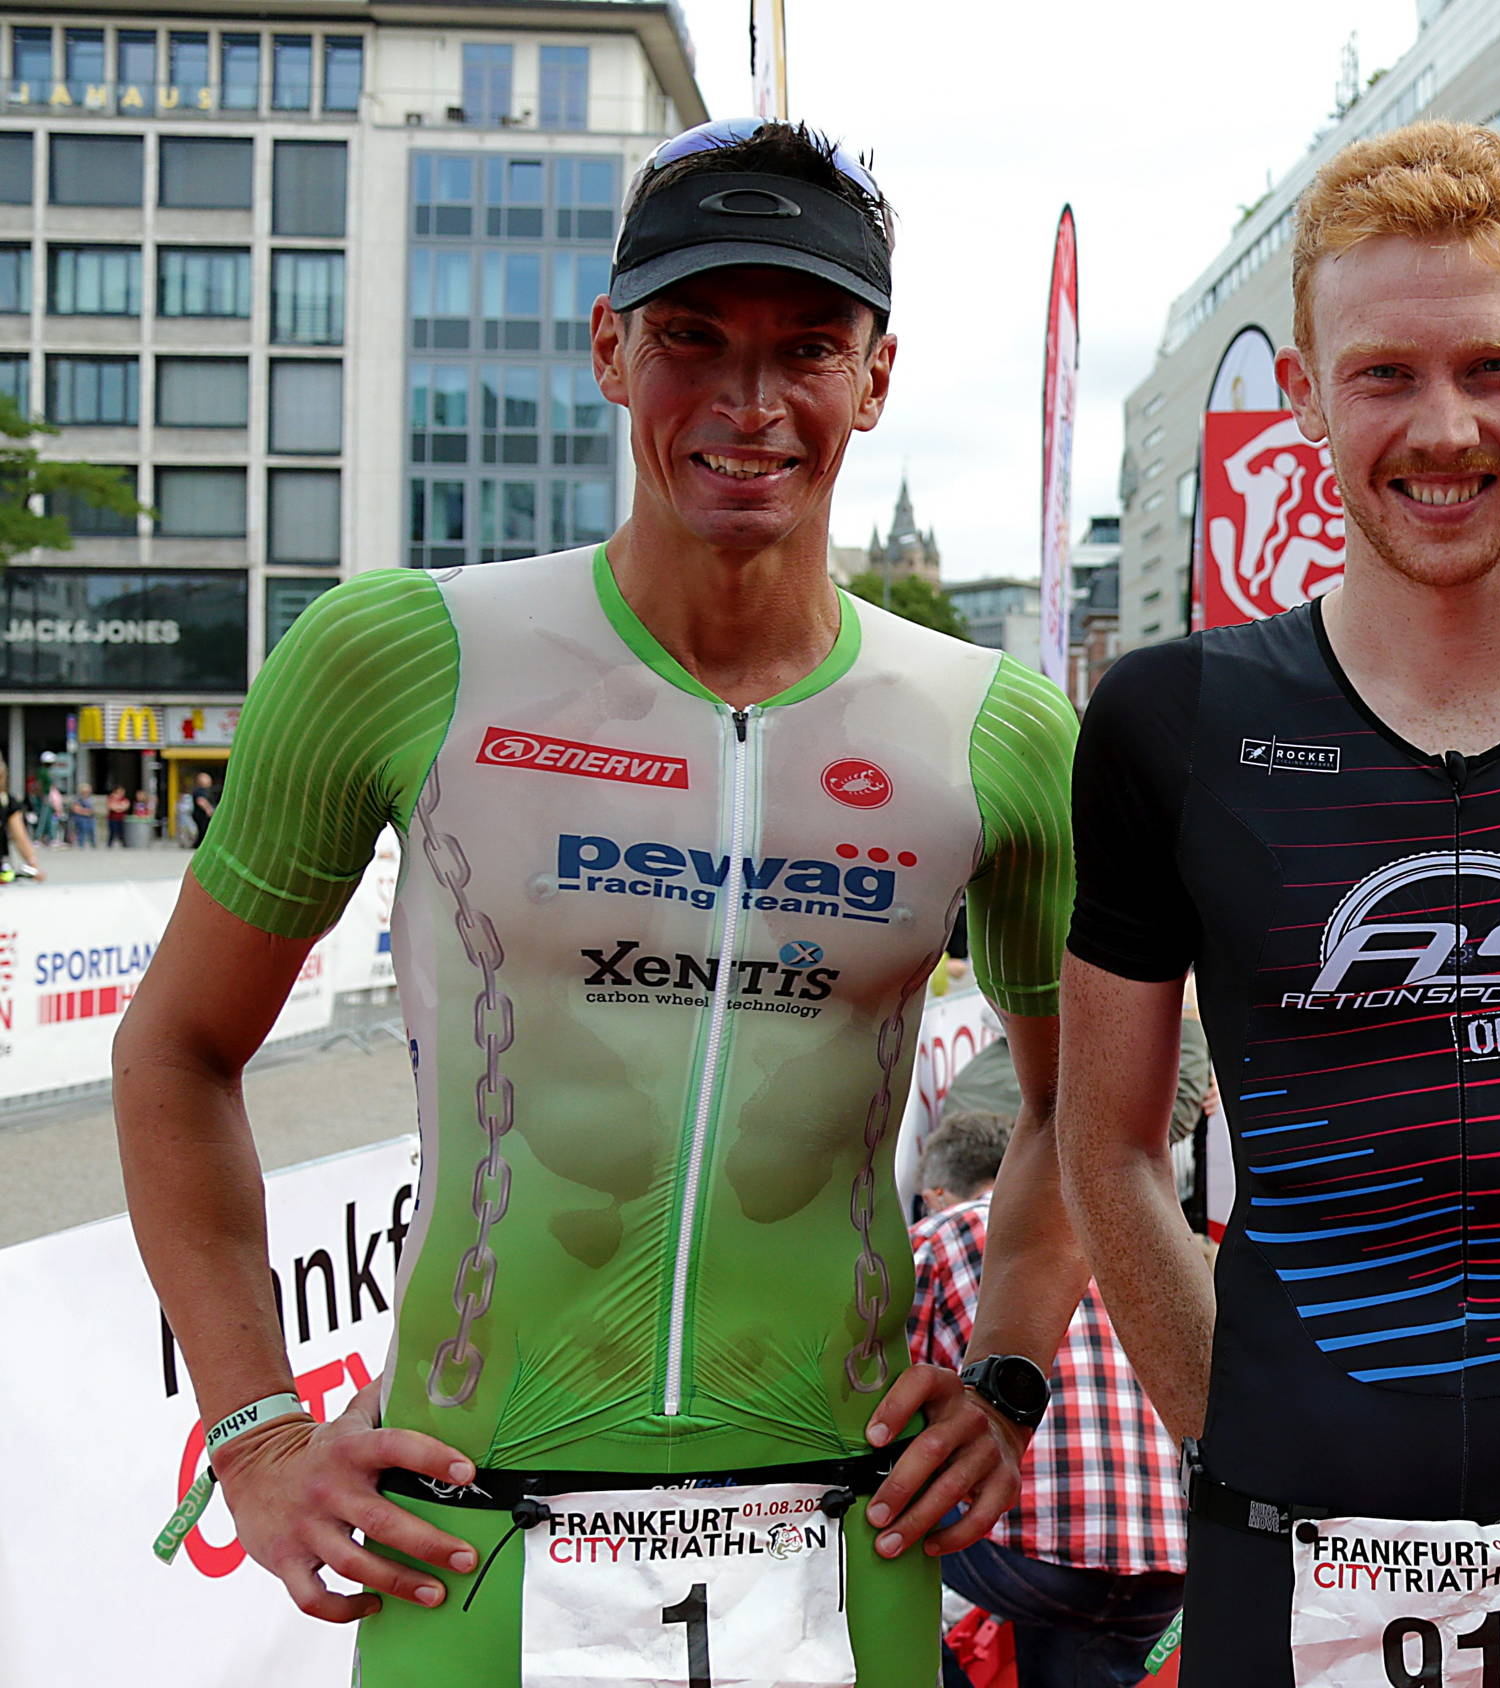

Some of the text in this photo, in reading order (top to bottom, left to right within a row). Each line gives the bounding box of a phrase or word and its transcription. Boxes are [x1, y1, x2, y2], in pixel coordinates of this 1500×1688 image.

[534, 744, 684, 783] ENERVIT
[1276, 749, 1336, 763] ROCKET
[557, 833, 897, 913] pewag
[586, 874, 840, 918] racing team
[585, 990, 824, 1020] carbon wheel technology
[549, 1497, 824, 1537] FRANKFURT 01.08.202
[1313, 1535, 1490, 1567] FRANKFURT
[661, 1582, 712, 1688] 1
